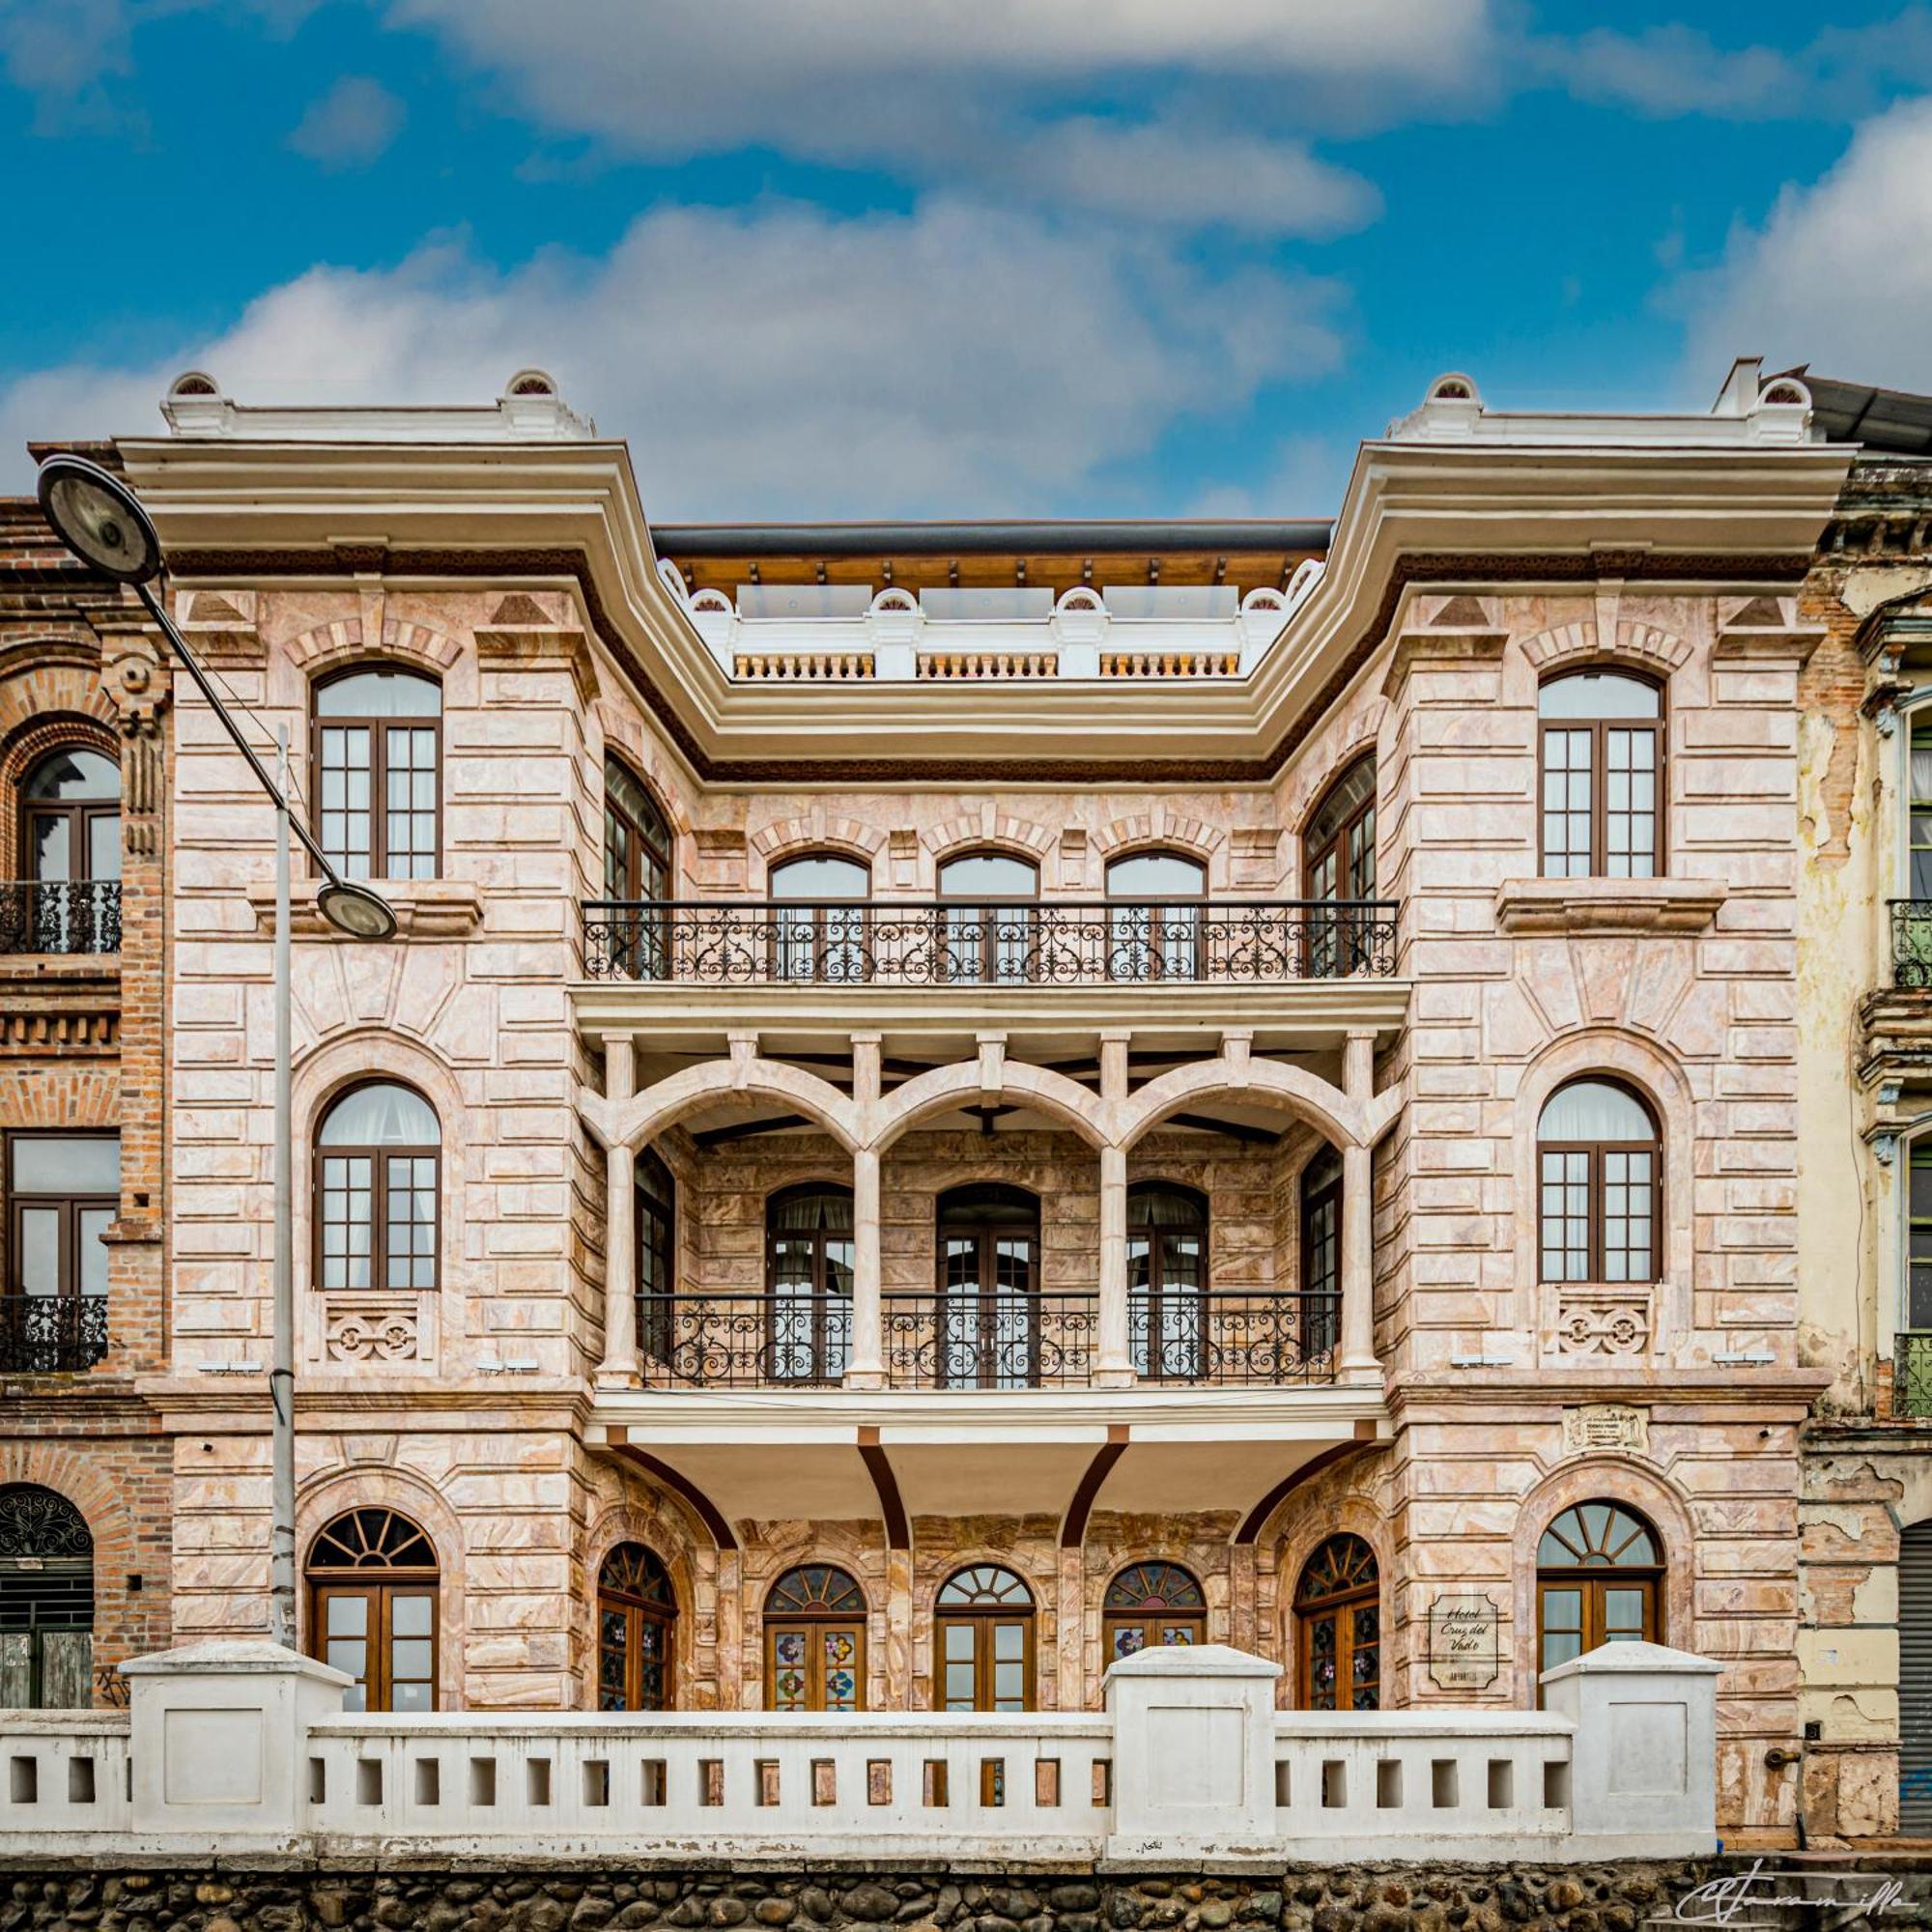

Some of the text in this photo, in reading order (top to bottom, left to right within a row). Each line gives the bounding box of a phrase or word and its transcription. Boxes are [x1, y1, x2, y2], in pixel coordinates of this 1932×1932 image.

[1447, 1606, 1481, 1620] Hotel
[1440, 1622, 1489, 1637] Cruz del
[1450, 1638, 1480, 1651] Vado
